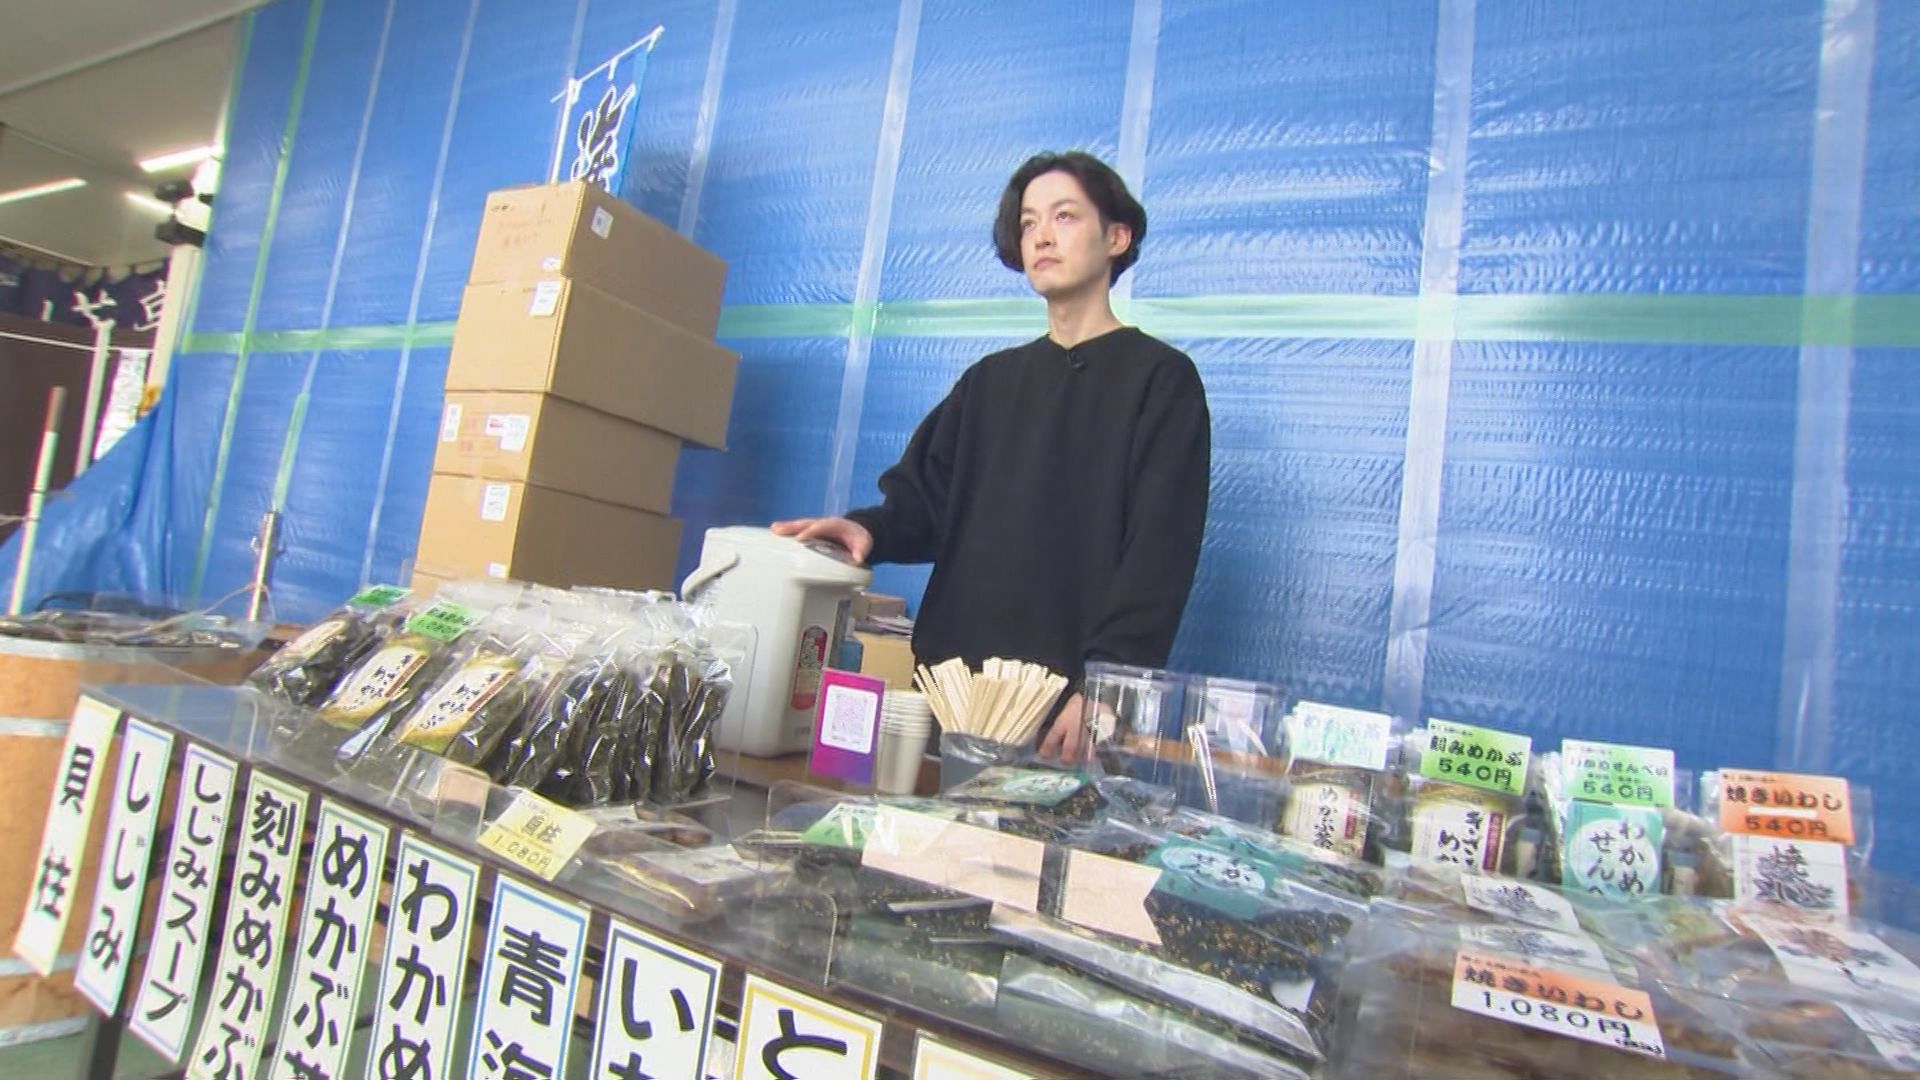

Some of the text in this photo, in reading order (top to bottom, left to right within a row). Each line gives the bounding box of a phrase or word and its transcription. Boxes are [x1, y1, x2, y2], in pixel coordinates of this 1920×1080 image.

[1429, 734, 1524, 768] 刻みめかぶ
[1438, 757, 1513, 788] 540円
[1582, 779, 1654, 801] 540円
[1726, 785, 1843, 812] 焼きいわし
[31, 744, 95, 920] 貝柱
[1744, 814, 1828, 836] 540円
[90, 750, 151, 971] しじみ
[146, 763, 222, 1022] しじみスープ
[202, 790, 297, 1080] 刻みめかぶ
[378, 858, 459, 1080] わかめ
[1463, 964, 1644, 1021] 焼きいわし
[760, 1008, 849, 1080] と
[1482, 990, 1632, 1041] 1.080円
